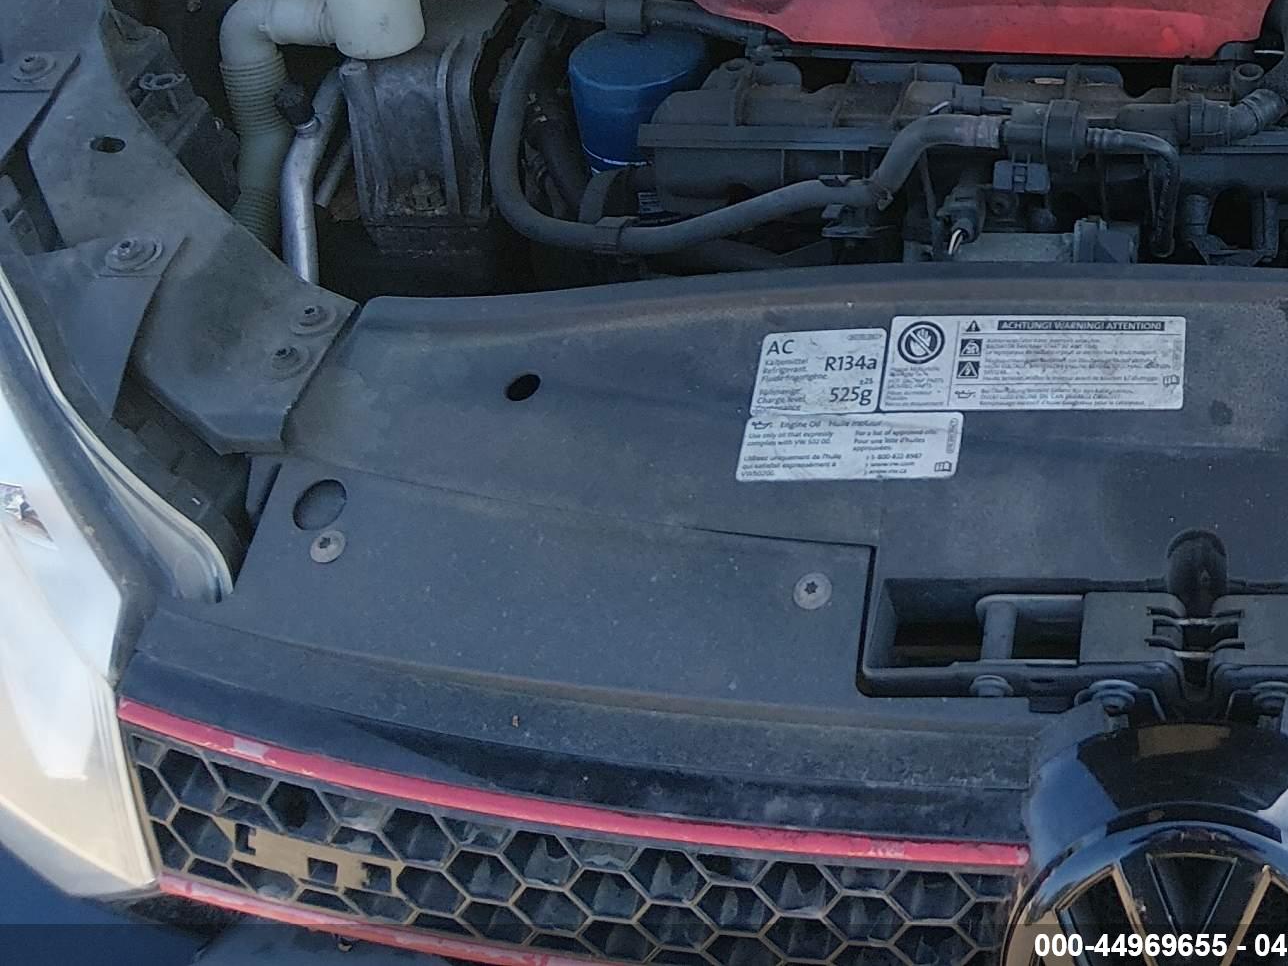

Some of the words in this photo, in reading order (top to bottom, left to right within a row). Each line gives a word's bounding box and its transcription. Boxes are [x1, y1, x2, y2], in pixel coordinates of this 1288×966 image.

[1001, 321, 1052, 330] ACHTUNG!
[1054, 321, 1105, 331] WARNING!
[1106, 322, 1162, 330] ATTENTION!
[766, 339, 795, 356] AC
[825, 355, 877, 372] R134a
[829, 386, 873, 406] 525g
[780, 421, 808, 429] Engine
[809, 420, 821, 428] Oil
